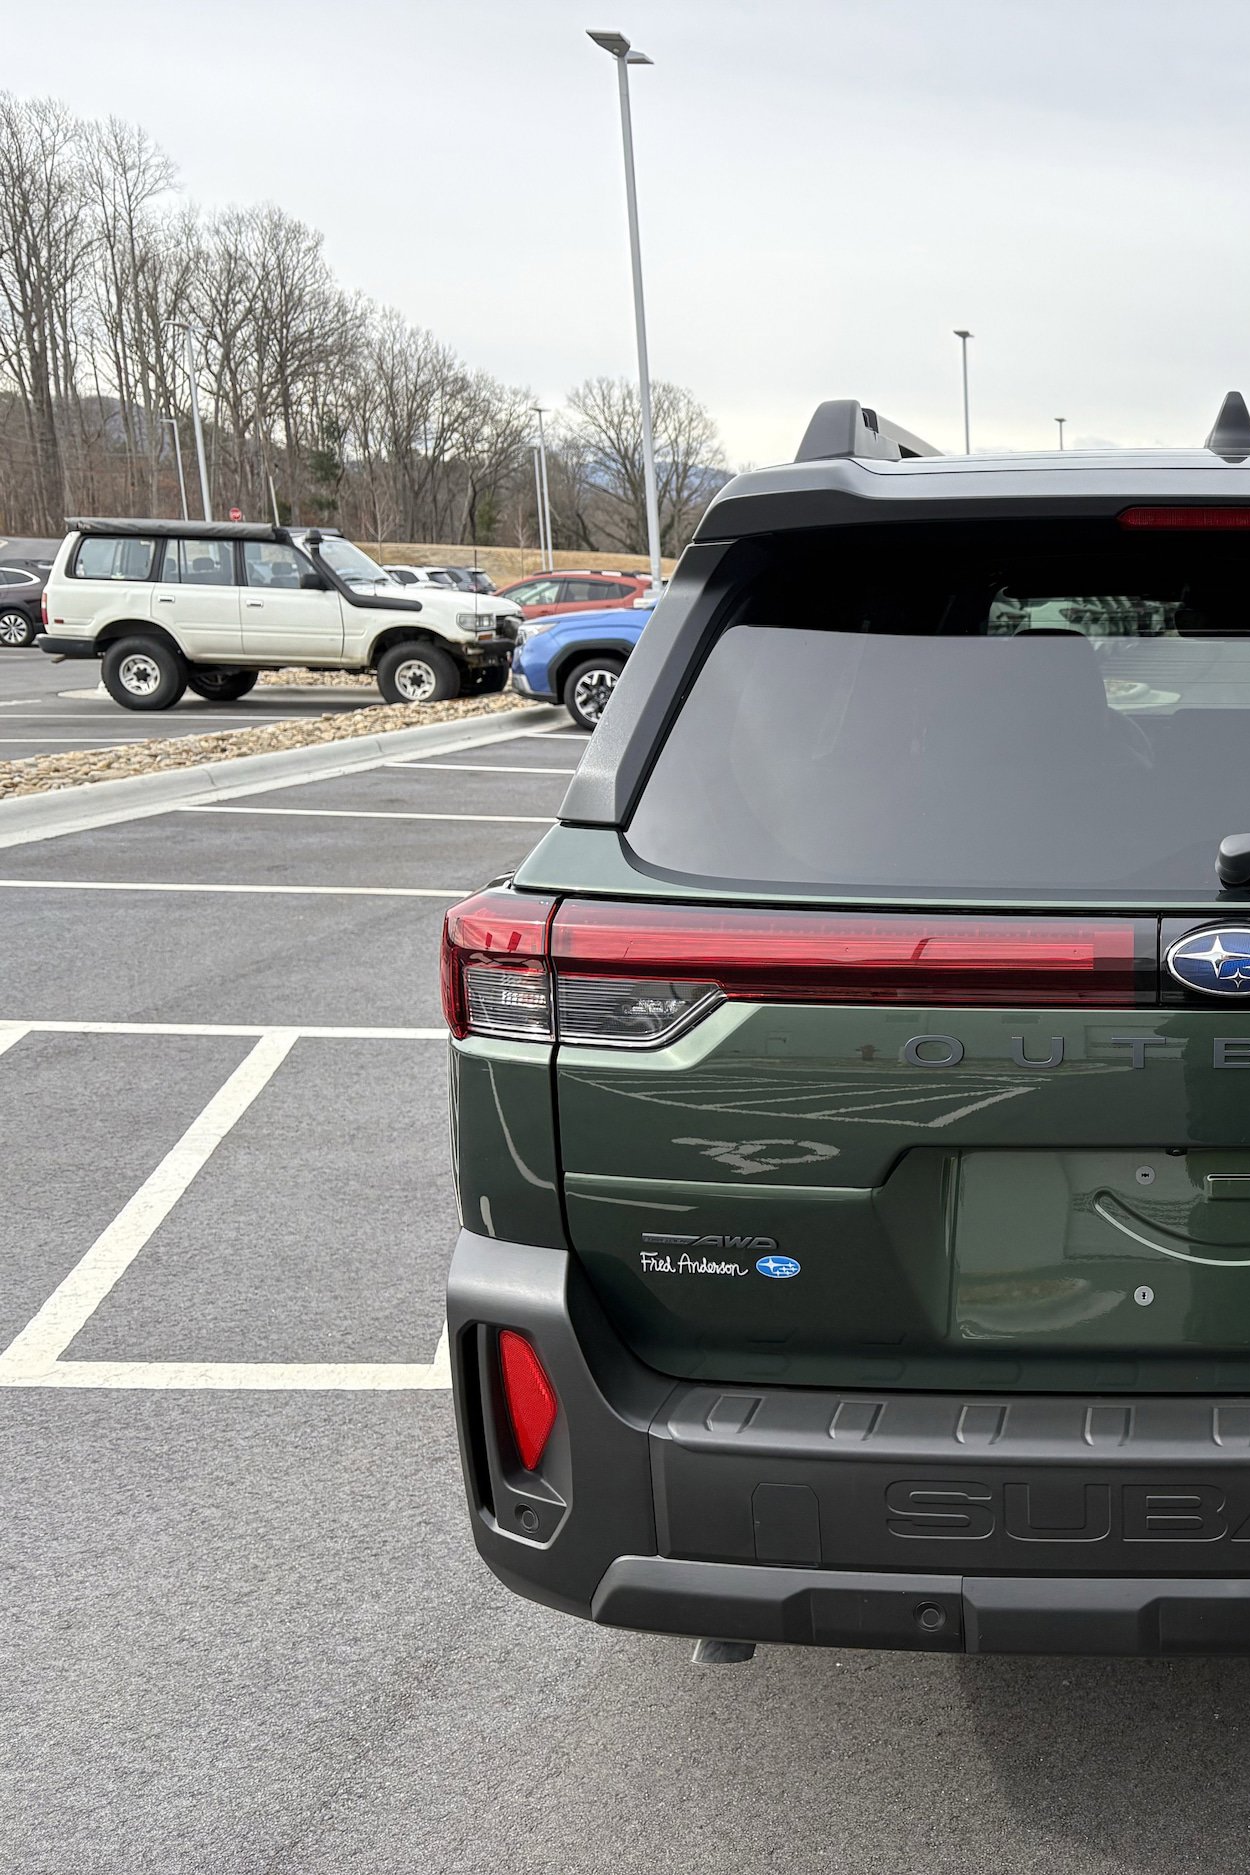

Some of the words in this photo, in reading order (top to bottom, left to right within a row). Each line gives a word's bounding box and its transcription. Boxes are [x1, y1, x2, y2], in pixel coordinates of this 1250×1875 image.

[692, 1235, 778, 1249] AWD
[640, 1251, 676, 1273] Fred
[677, 1253, 749, 1276] Anderson
